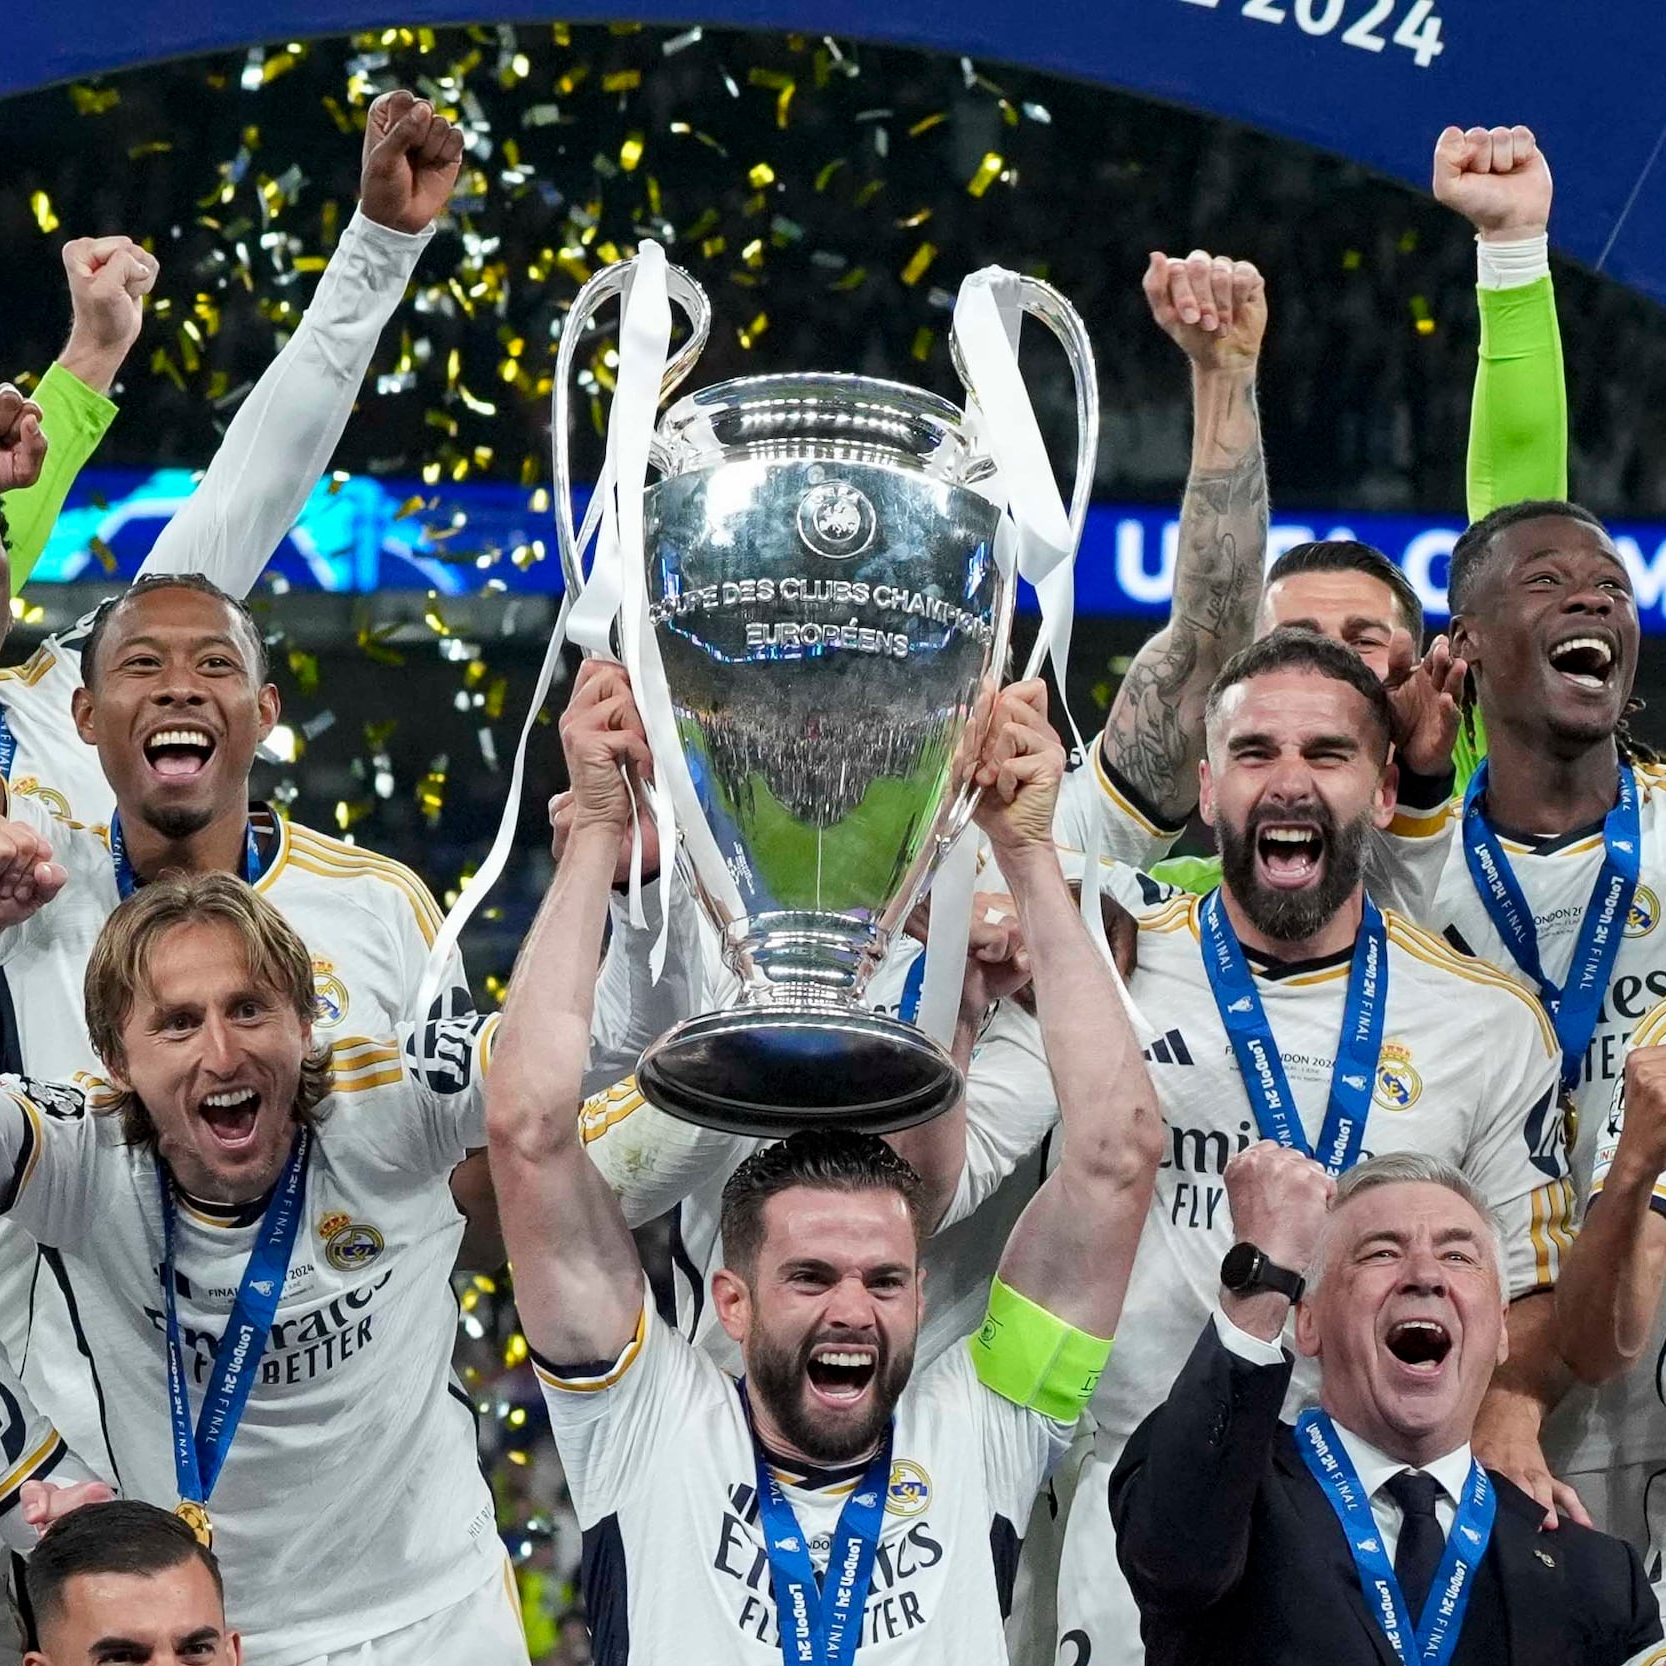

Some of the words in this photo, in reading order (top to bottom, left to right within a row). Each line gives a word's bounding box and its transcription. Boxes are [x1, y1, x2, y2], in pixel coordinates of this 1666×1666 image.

[722, 578, 774, 605] DES
[780, 577, 870, 606] CLUBS
[745, 617, 910, 658] EUROPÉENS
[1534, 910, 1570, 925] ONDON
[1595, 925, 1610, 944] 24
[1579, 949, 1606, 989] FINAL
[1364, 979, 1375, 997] 24
[1356, 1000, 1373, 1041] FINAL
[1172, 1183, 1223, 1230] FLY
[290, 1265, 314, 1279] 2024
[264, 1316, 373, 1385] BETTER
[222, 1374, 236, 1393] 24
[206, 1396, 232, 1444] FINAL
[740, 1596, 780, 1646] FL
[1440, 1598, 1454, 1615] 24
[798, 1641, 812, 1660] 24
[1424, 1620, 1450, 1658] FINAL
